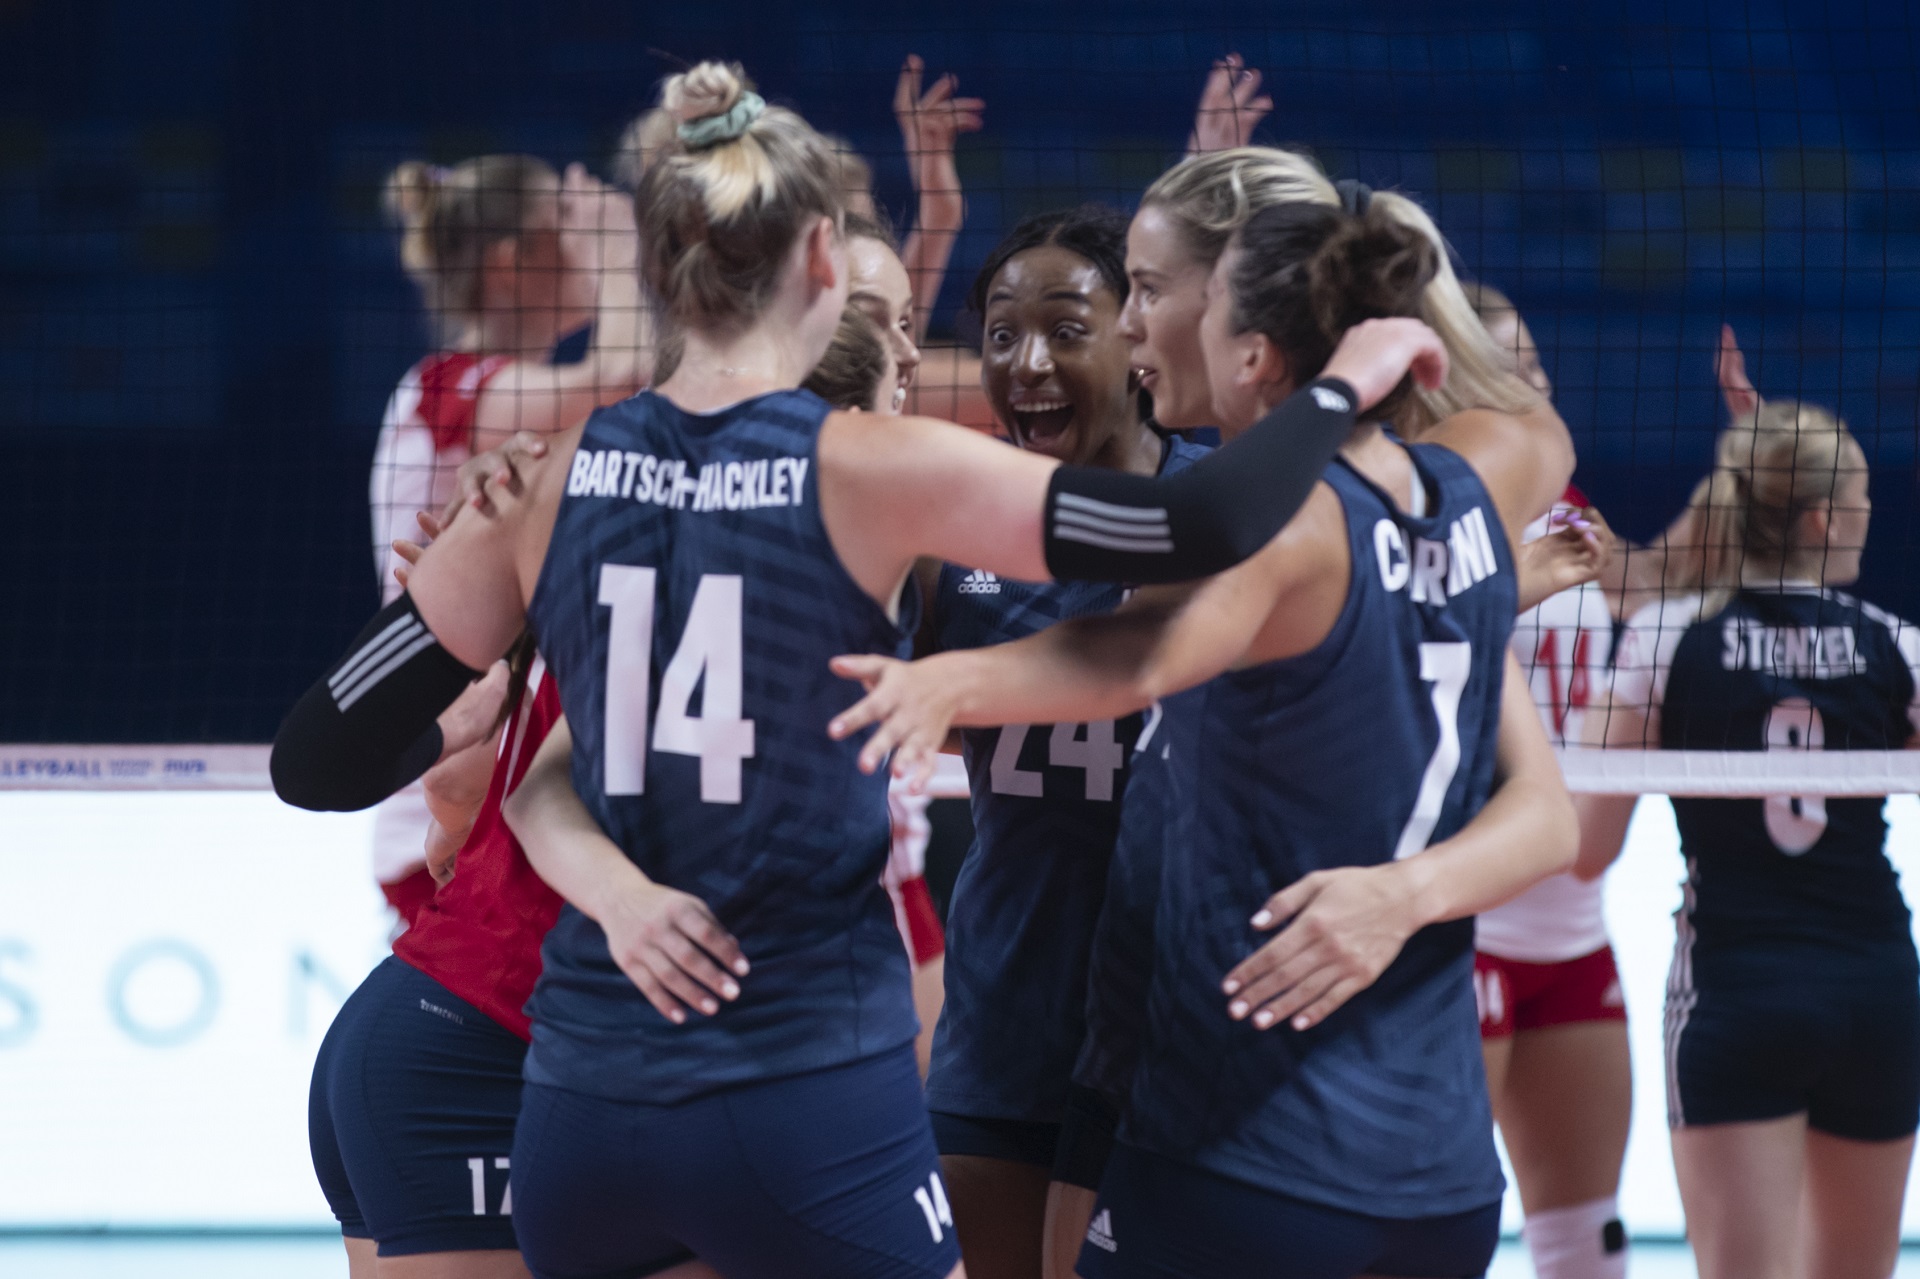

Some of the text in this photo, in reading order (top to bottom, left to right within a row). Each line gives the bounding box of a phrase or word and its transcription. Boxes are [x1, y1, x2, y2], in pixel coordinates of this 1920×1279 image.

[567, 449, 809, 512] BARTSCH-HACKLEY
[958, 580, 1001, 594] adidas
[1721, 616, 1868, 679] STENZEL
[597, 562, 756, 805] 14
[1392, 641, 1472, 861] 7
